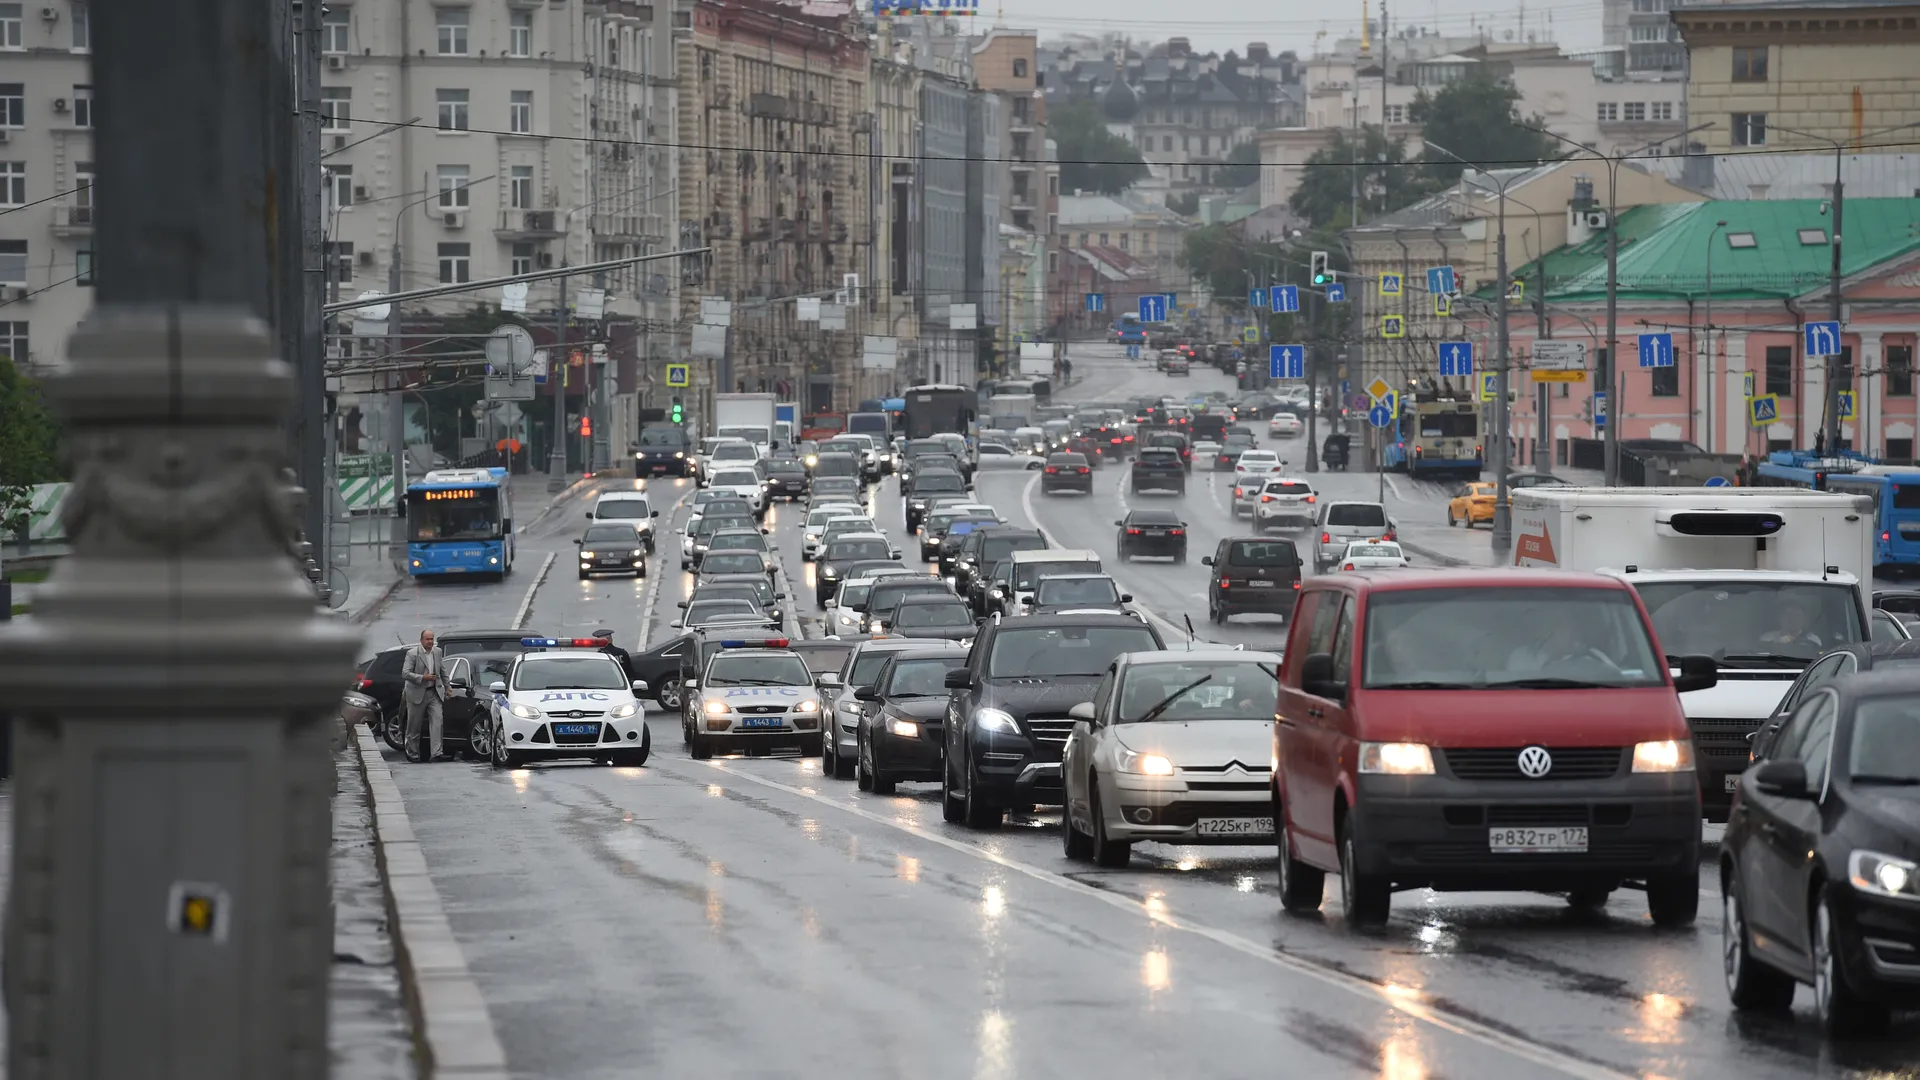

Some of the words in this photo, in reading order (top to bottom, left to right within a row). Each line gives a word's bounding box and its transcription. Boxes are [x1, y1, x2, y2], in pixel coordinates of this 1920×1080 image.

[540, 692, 609, 702] ДПС
[725, 687, 799, 698] ДПС
[753, 718, 770, 726] 1443
[566, 724, 584, 733] 1440
[1202, 819, 1251, 832] Т225КР
[1254, 818, 1273, 829] 199
[1494, 830, 1557, 845] Р832ТР
[1561, 828, 1584, 841] 177
